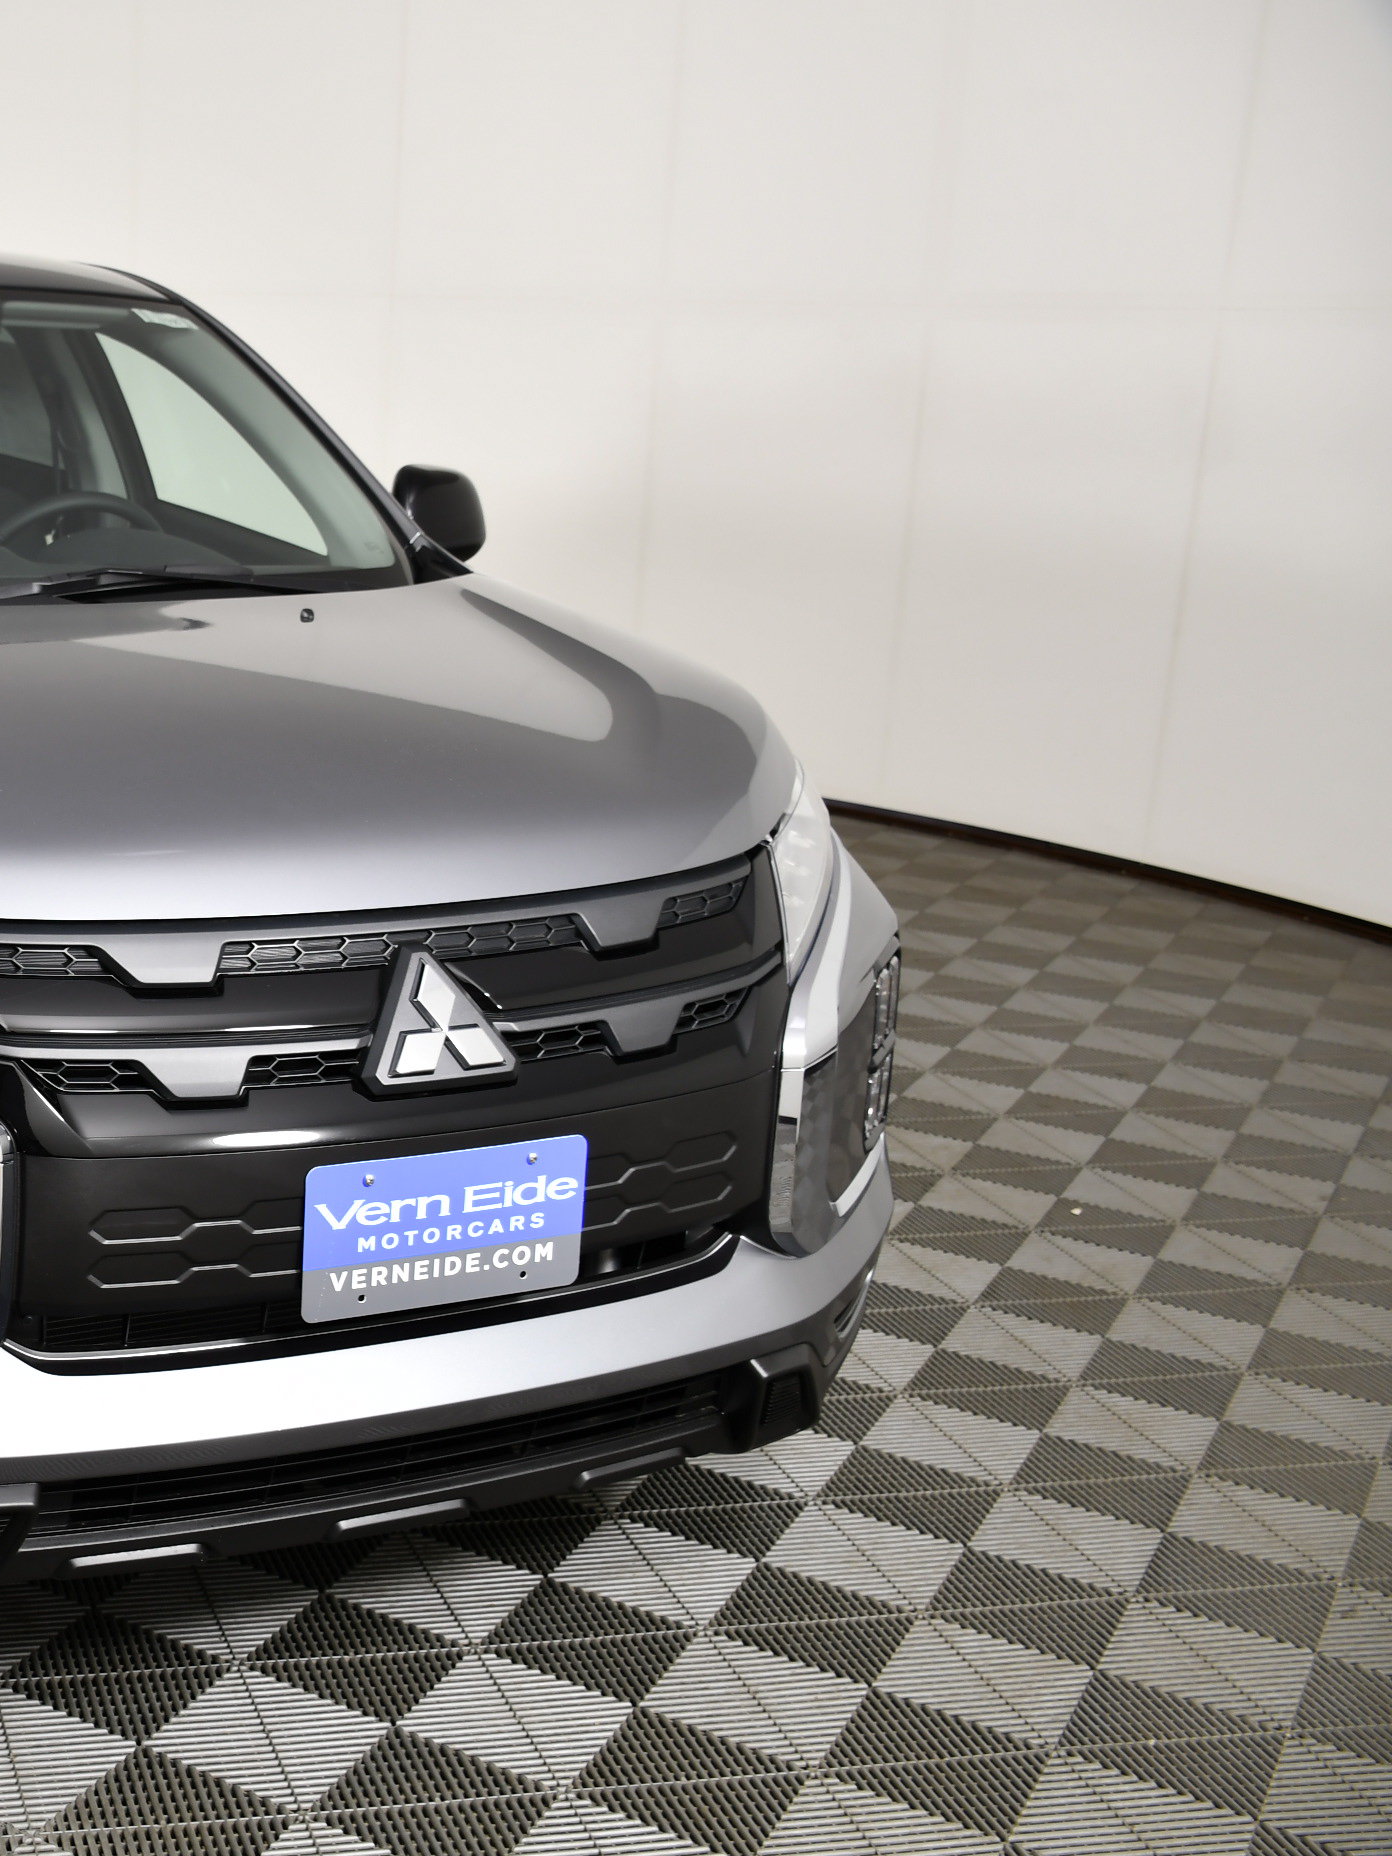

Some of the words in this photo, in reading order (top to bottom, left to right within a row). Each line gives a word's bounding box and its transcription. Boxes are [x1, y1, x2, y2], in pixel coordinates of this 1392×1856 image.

[314, 1193, 451, 1231] Vern
[462, 1174, 579, 1214] Eide
[357, 1212, 545, 1252] MOTORCARS
[329, 1241, 554, 1291] VERNEIDE.COM
